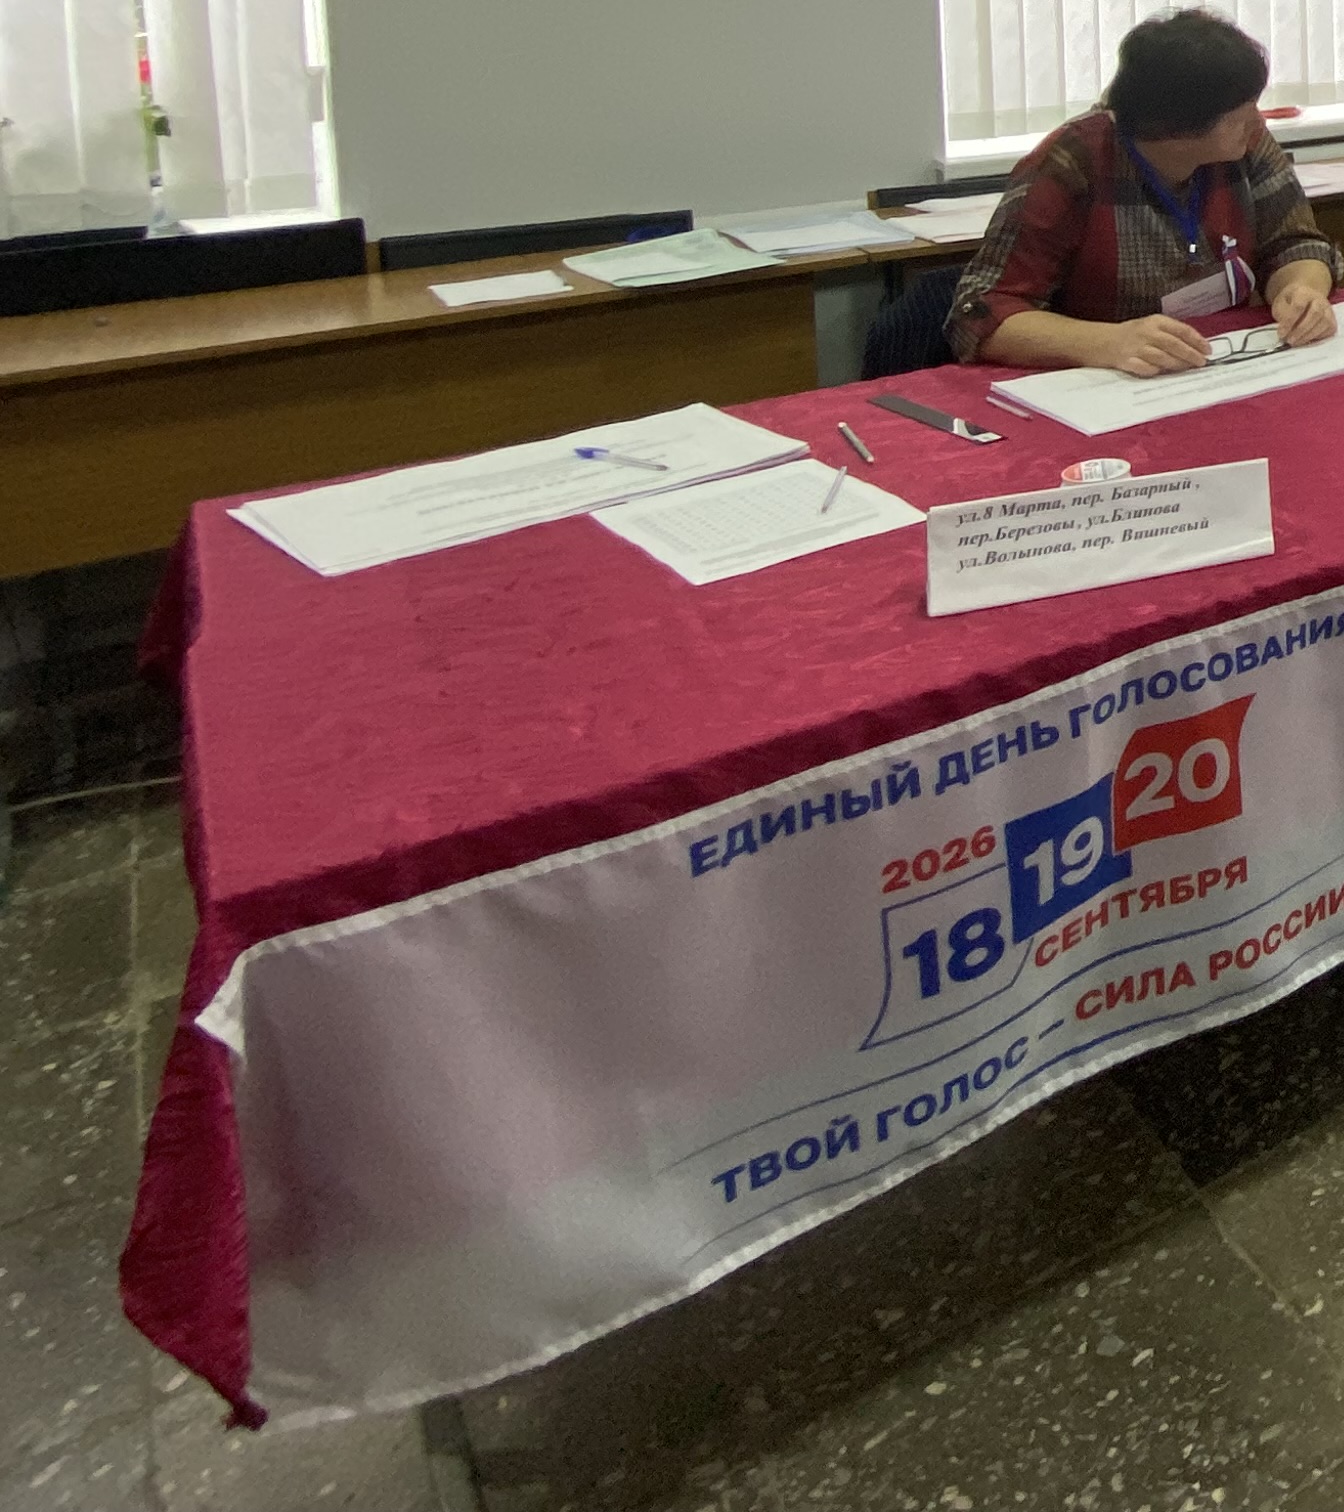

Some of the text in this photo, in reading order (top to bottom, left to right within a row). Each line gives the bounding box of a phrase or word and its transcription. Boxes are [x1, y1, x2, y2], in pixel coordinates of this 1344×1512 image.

[1001, 496, 1066, 519] Марта,
[1072, 493, 1104, 511] пер.
[1082, 535, 1115, 552] пер.
[1121, 517, 1209, 543] Вишневый
[689, 760, 921, 878] ЕДИНЫЙ
[935, 722, 1060, 795] ДЕНЬ
[881, 826, 996, 893] 2026
[902, 737, 1231, 1000] 18 19 20
[1035, 856, 1249, 968] СЕНТЯБРЯ
[711, 1116, 859, 1204] ТВОЙ
[876, 1036, 1029, 1144] ГОЛОС
[1075, 963, 1196, 1022] СИЛА
